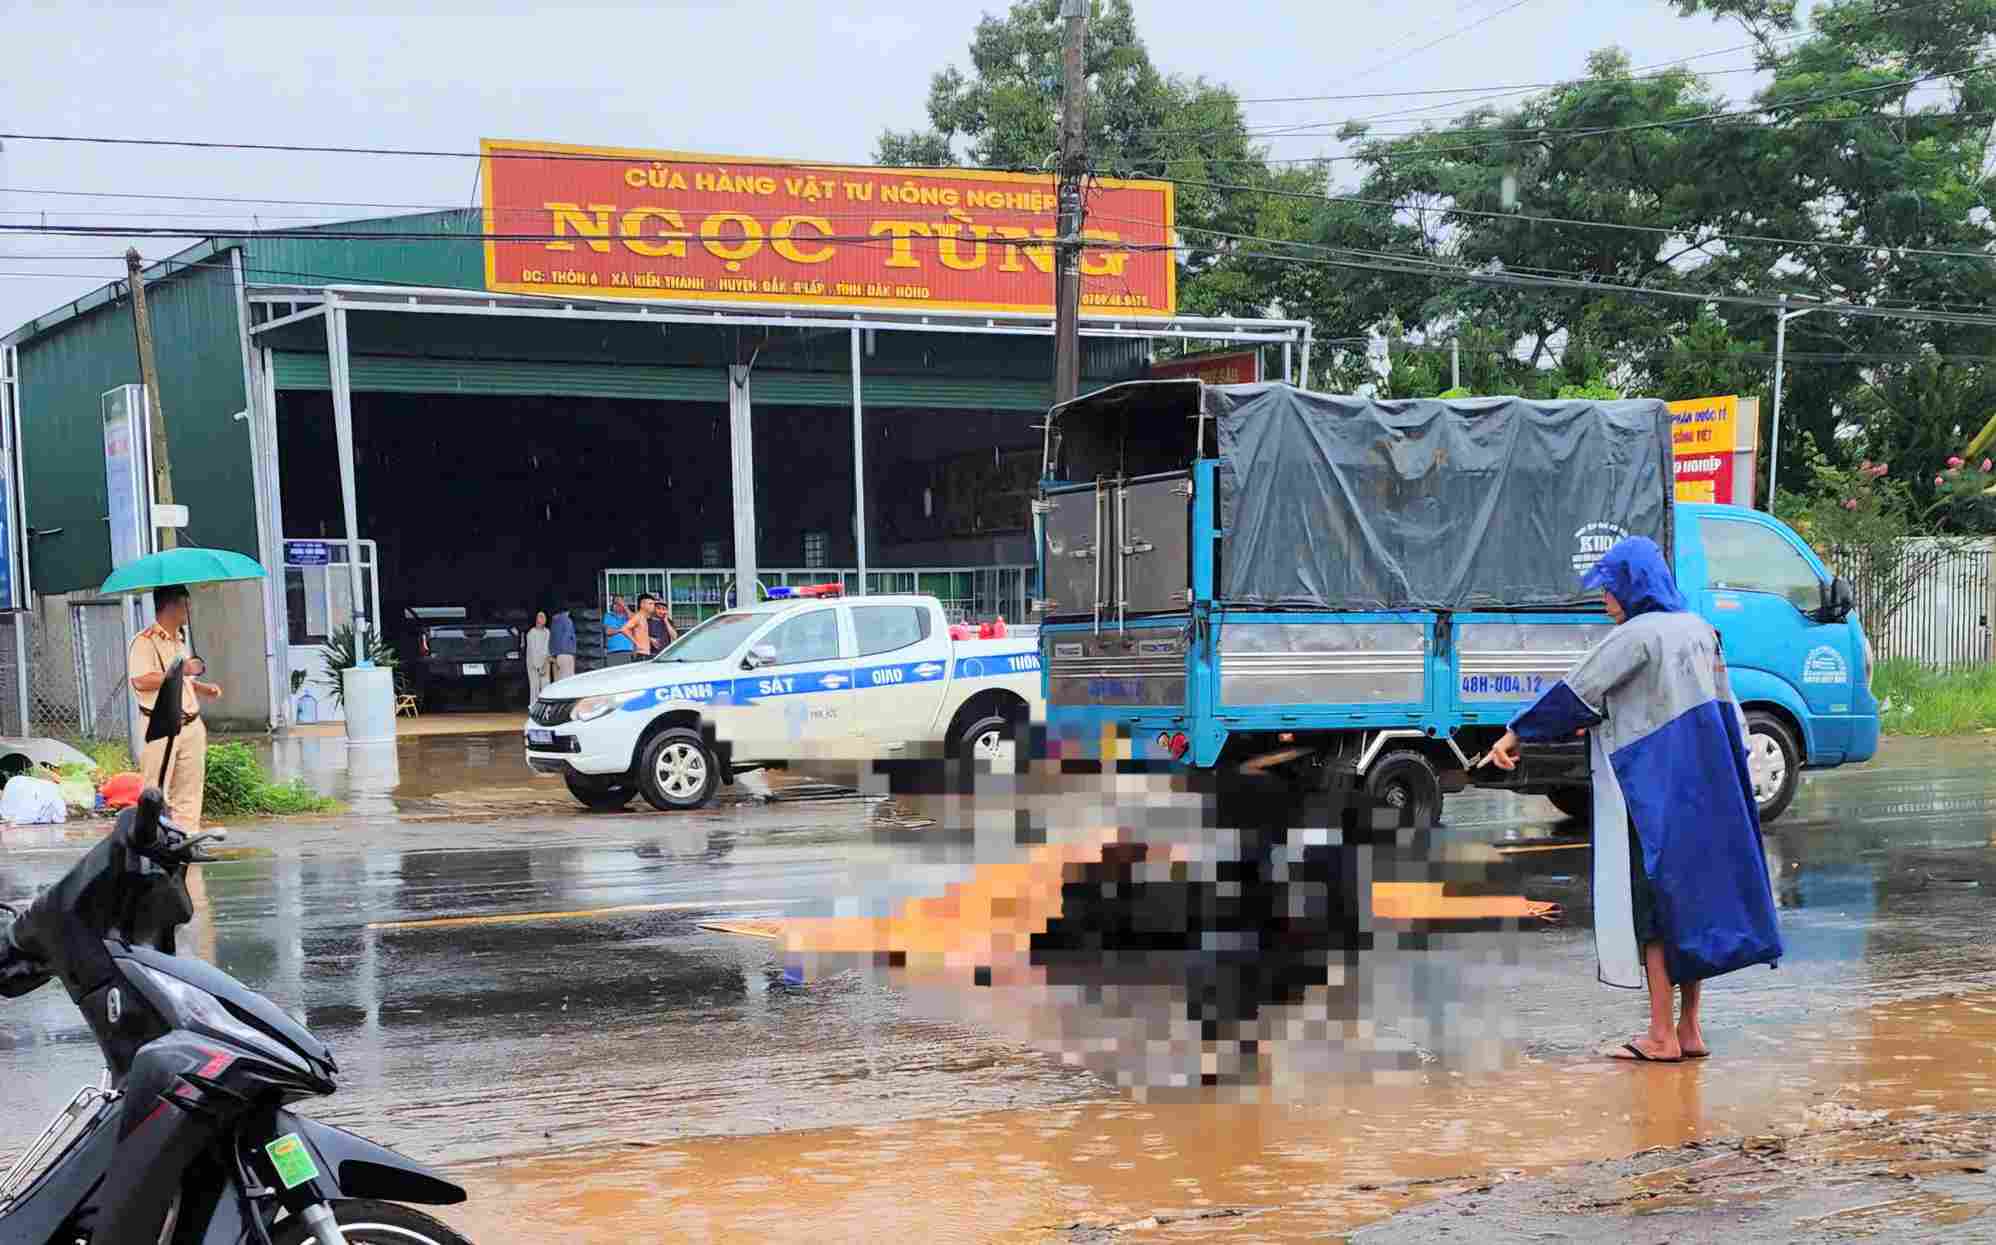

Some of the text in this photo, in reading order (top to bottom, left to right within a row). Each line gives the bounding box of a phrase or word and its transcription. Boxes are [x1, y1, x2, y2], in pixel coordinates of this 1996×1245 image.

[624, 162, 688, 191] CỬA
[696, 167, 776, 194] HÀNG
[785, 175, 835, 203] VẬT
[880, 182, 960, 206] NÔNG
[966, 190, 1057, 214] NGHIỆP
[543, 202, 836, 272] NGỌC
